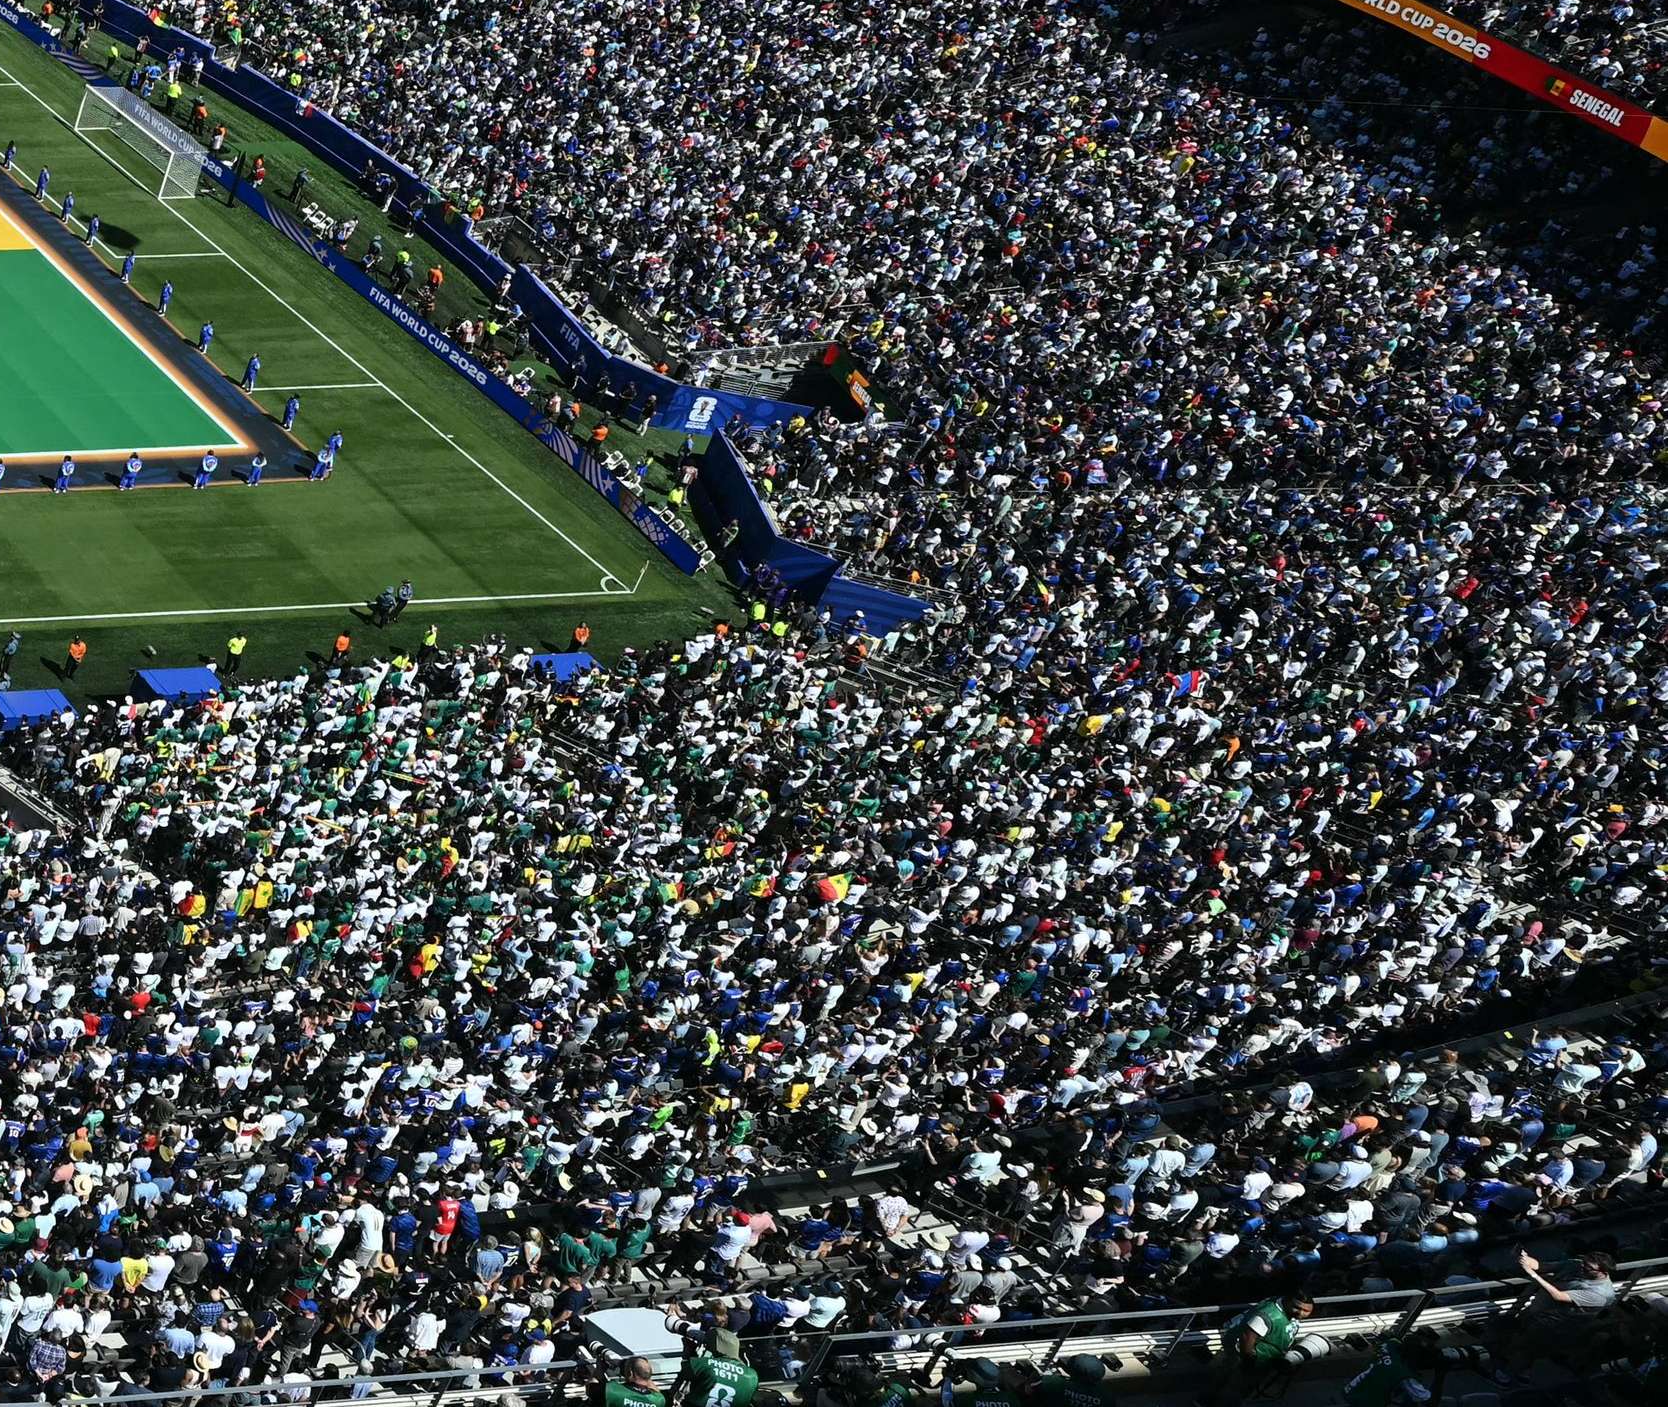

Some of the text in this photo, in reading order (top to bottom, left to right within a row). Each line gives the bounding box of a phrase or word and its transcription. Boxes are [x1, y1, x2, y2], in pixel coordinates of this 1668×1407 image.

[1401, 6, 1434, 31] CUP
[1432, 22, 1492, 61] 2026
[1570, 89, 1624, 127] SENEGAL
[134, 103, 223, 177] FIFA WORLD CUP 2026
[369, 287, 488, 385] FIFA WORLD CUP 2026
[560, 322, 579, 351] FIFA
